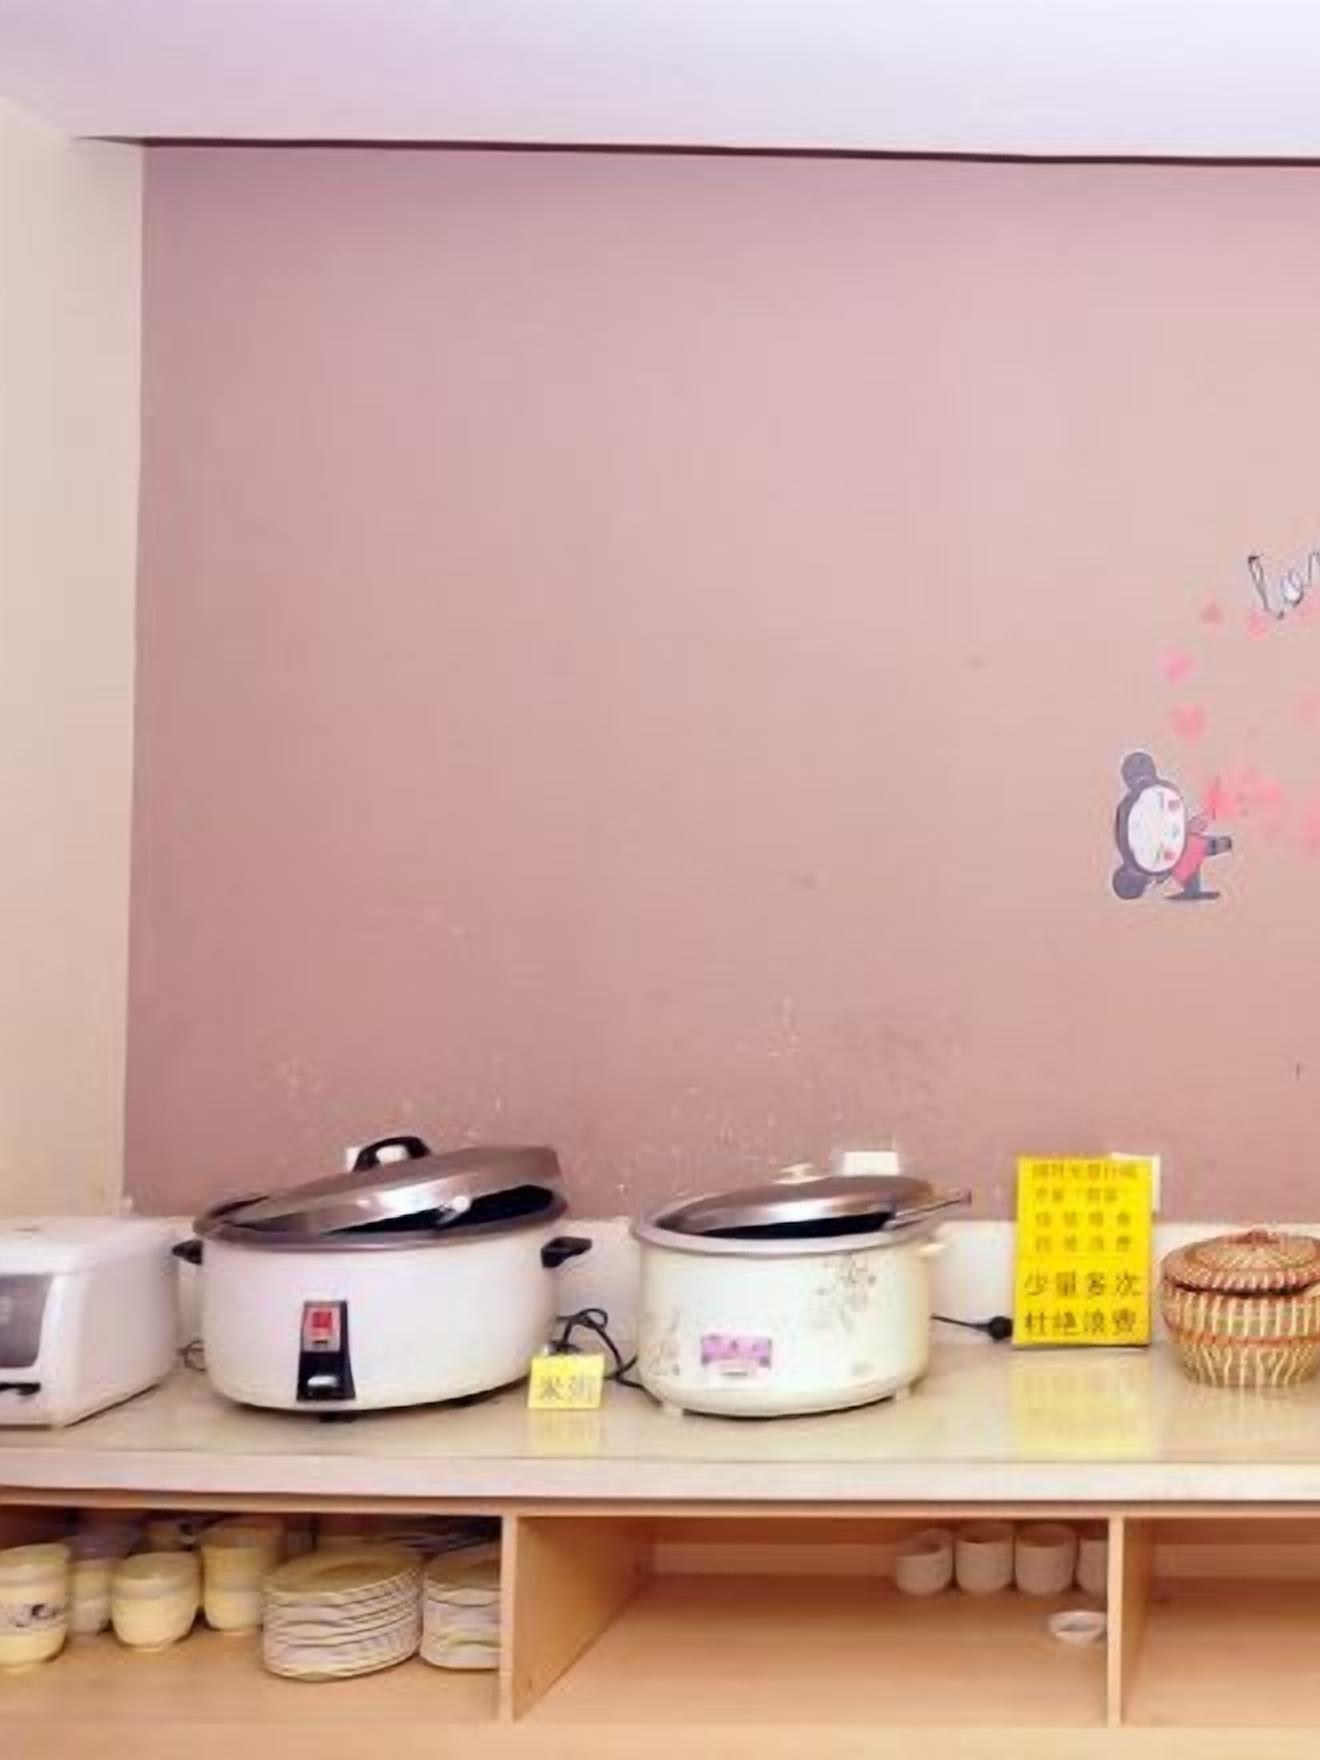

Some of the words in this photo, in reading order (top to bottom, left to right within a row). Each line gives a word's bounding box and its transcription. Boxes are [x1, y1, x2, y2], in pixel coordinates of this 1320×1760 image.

[1023, 1271, 1141, 1298] 少量多次
[1024, 1308, 1138, 1336] 杜绝浪费
